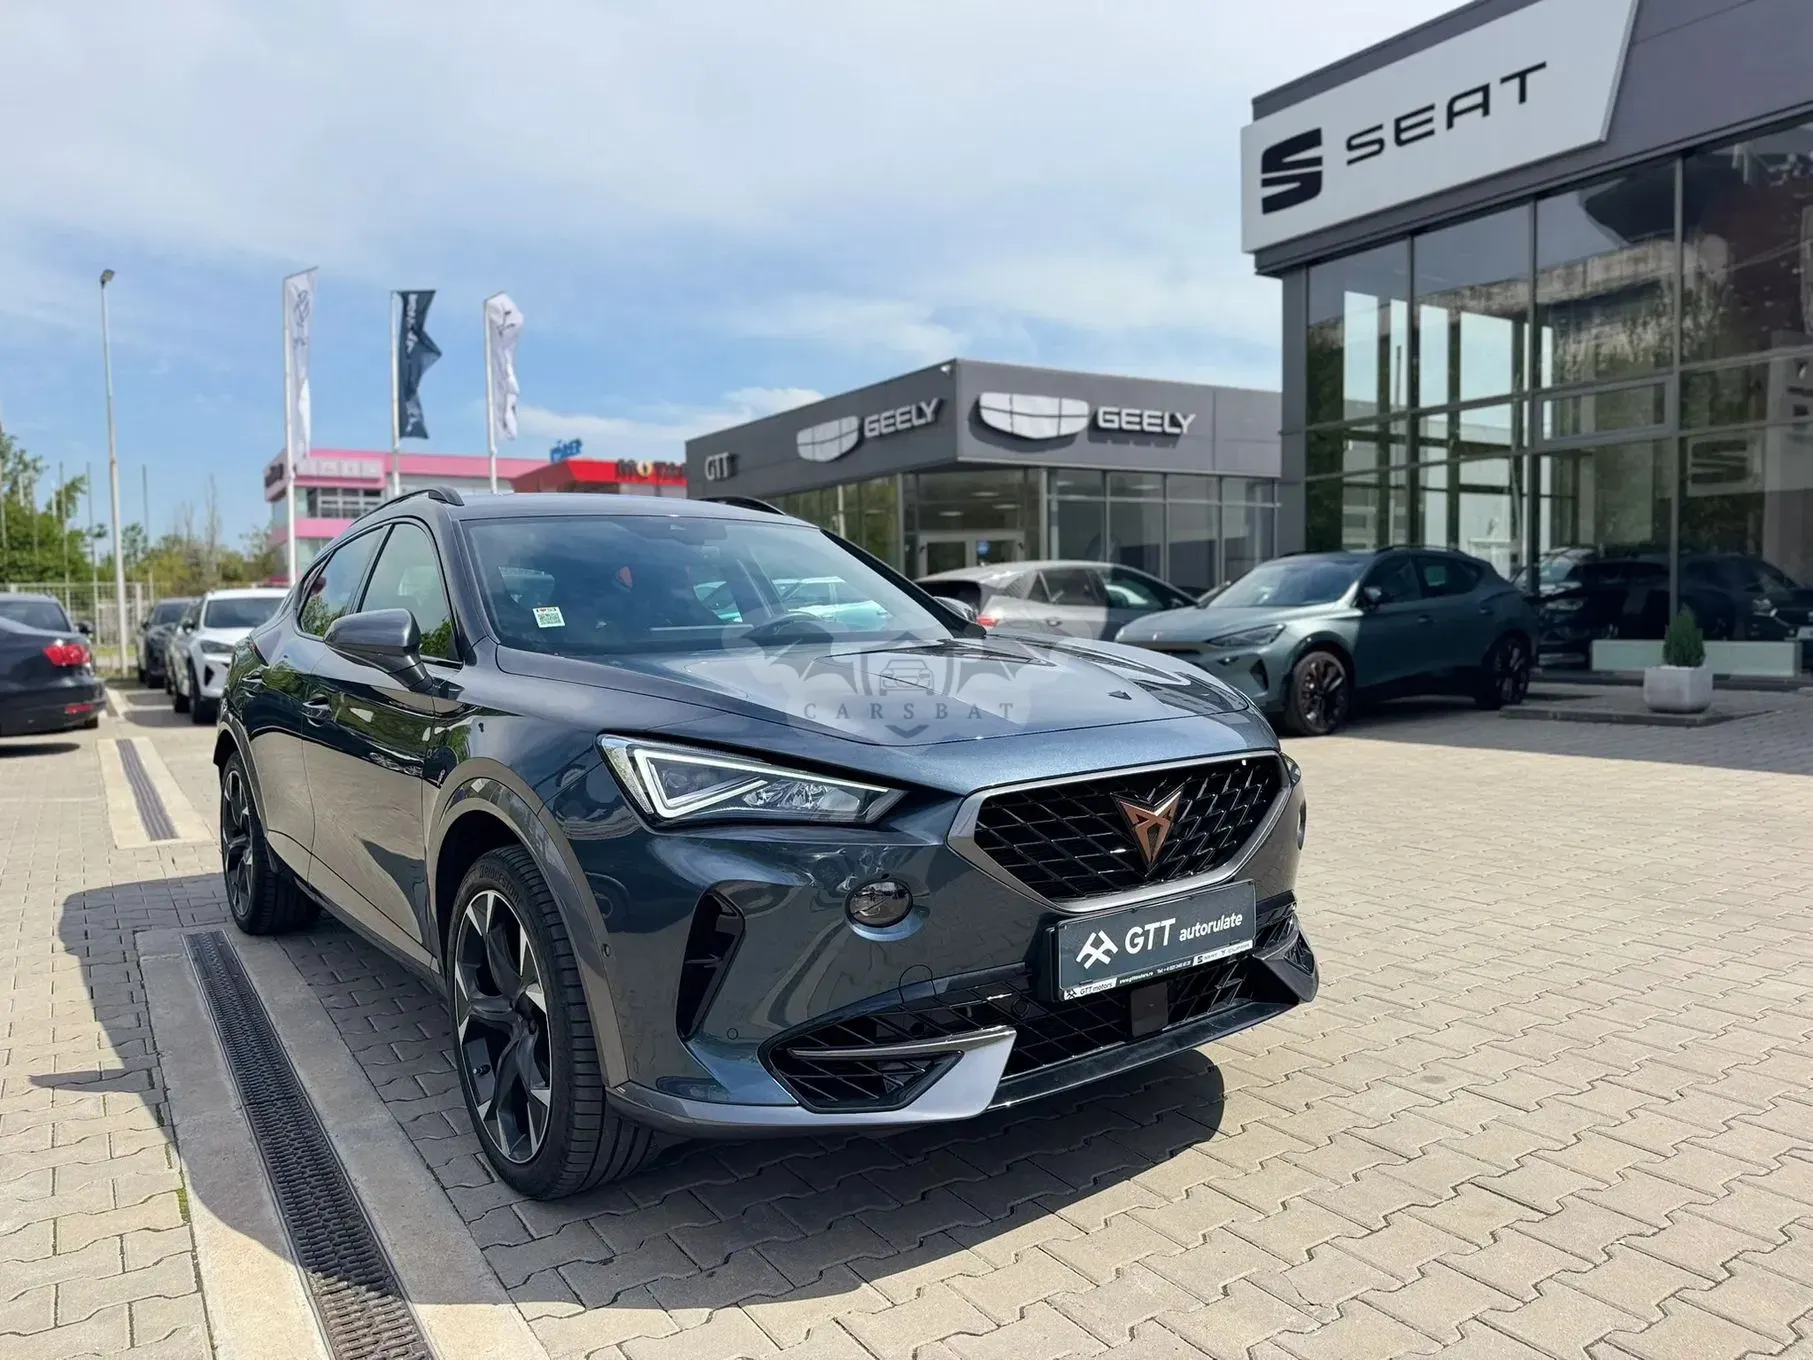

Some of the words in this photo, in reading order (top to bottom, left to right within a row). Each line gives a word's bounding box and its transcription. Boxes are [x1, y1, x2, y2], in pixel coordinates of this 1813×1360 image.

[1345, 61, 1546, 166] SEAT
[863, 398, 938, 437] GEELY
[1097, 406, 1196, 436] GEELY
[705, 452, 729, 480] GTT
[1125, 918, 1176, 954] GTT
[1179, 913, 1243, 942] autorulate
[1079, 985, 1093, 995] GTT
